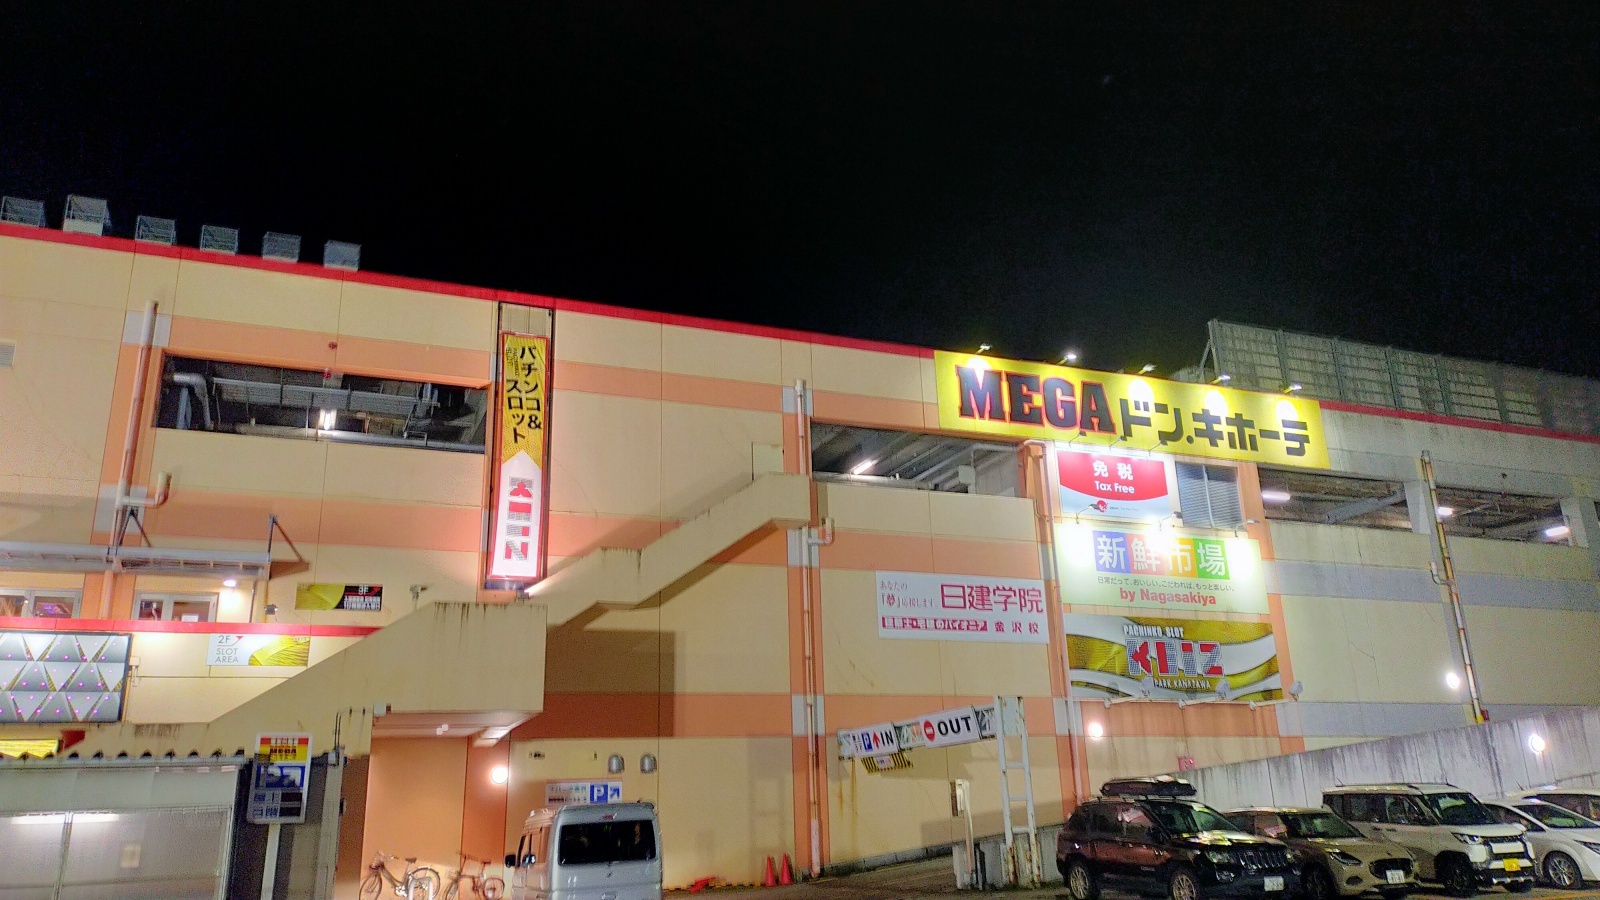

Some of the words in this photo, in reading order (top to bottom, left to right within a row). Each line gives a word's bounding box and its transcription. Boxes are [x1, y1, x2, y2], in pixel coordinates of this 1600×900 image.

[519, 345, 542, 430] パチンコ&
[955, 364, 1117, 435] MEGA
[506, 378, 526, 444] スロット
[1094, 480, 1112, 491] Tax
[1114, 482, 1135, 493] Free
[1097, 534, 1228, 577] 新鮮市場
[940, 583, 1045, 614] 日建学院
[1119, 587, 1136, 605] by
[1140, 588, 1217, 607] Nagasakiya
[218, 635, 231, 644] 2F
[1123, 625, 1163, 637] PACHINKO
[1165, 626, 1184, 638] SLOT
[214, 656, 239, 664] AREA
[216, 647, 239, 656] SLOT
[937, 716, 972, 736] OUT
[880, 731, 894, 747] IN
